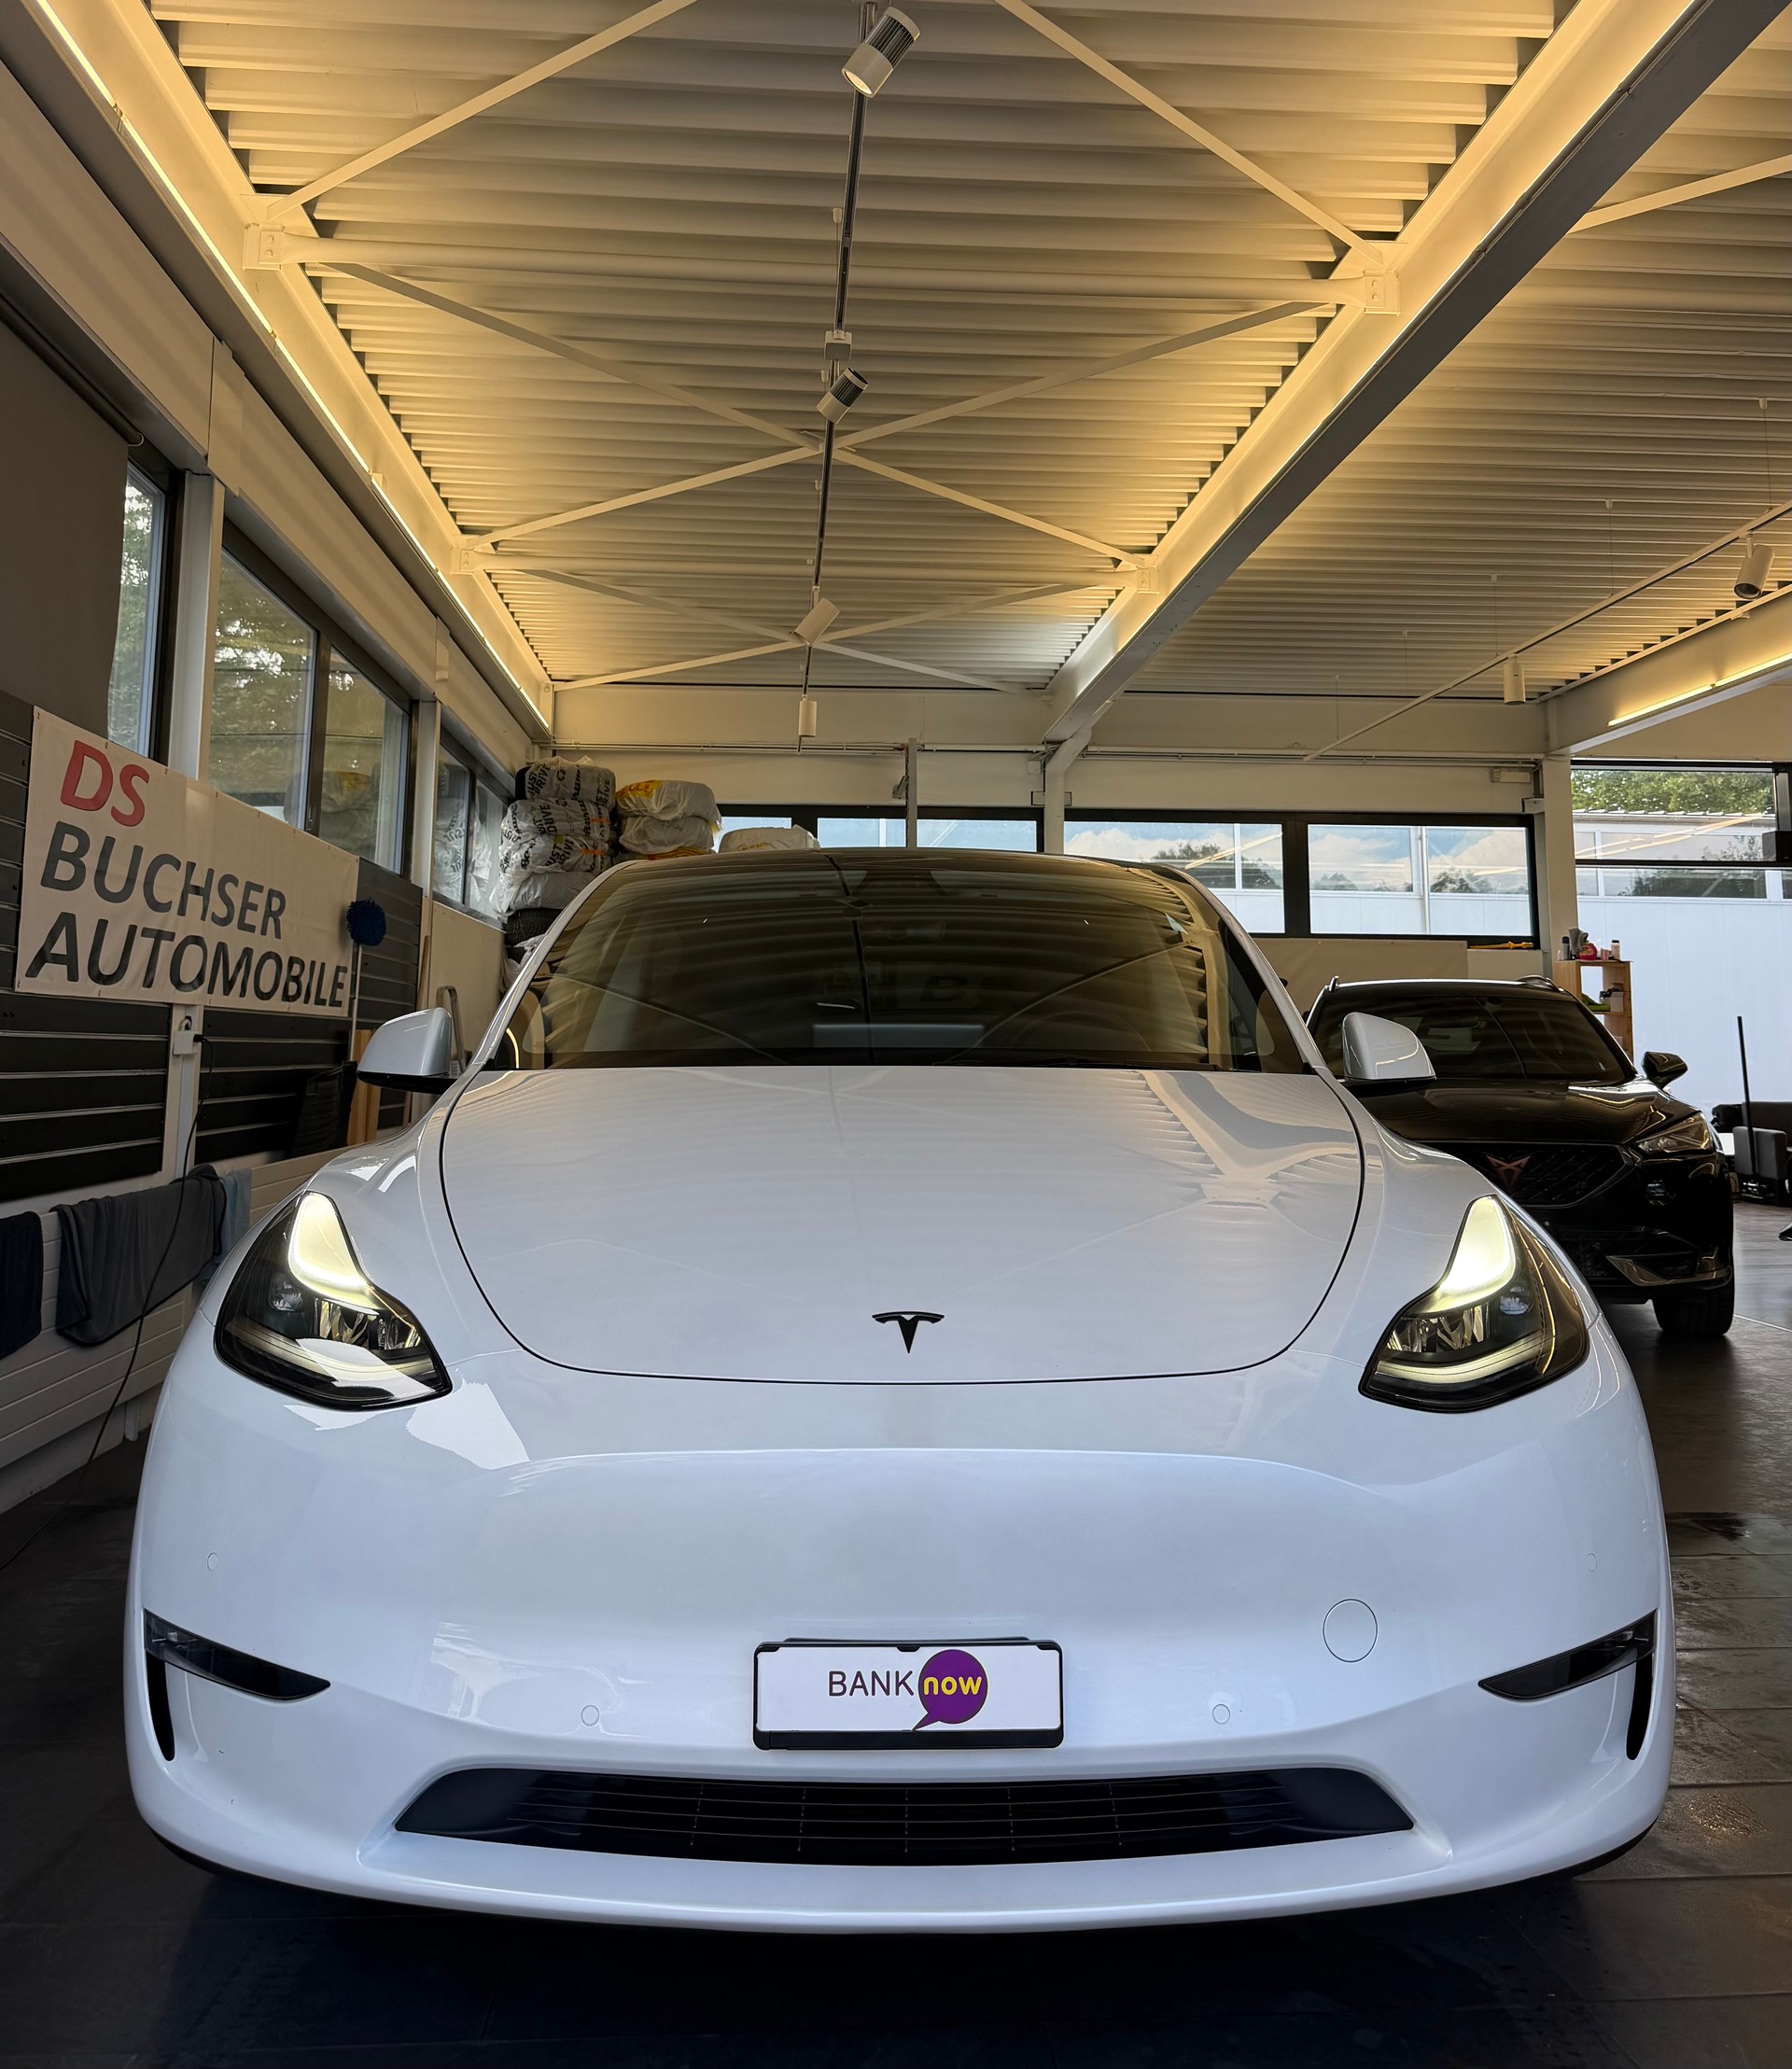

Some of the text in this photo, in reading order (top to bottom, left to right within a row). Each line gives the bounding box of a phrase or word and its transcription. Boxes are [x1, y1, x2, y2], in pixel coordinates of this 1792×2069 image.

[60, 740, 150, 827] DS
[526, 771, 538, 796] JUST
[534, 763, 551, 795] DRIVE
[40, 821, 287, 939] BUCHSER
[25, 912, 348, 1008] AUTOMOBILE
[828, 1671, 982, 1697] BANK now
